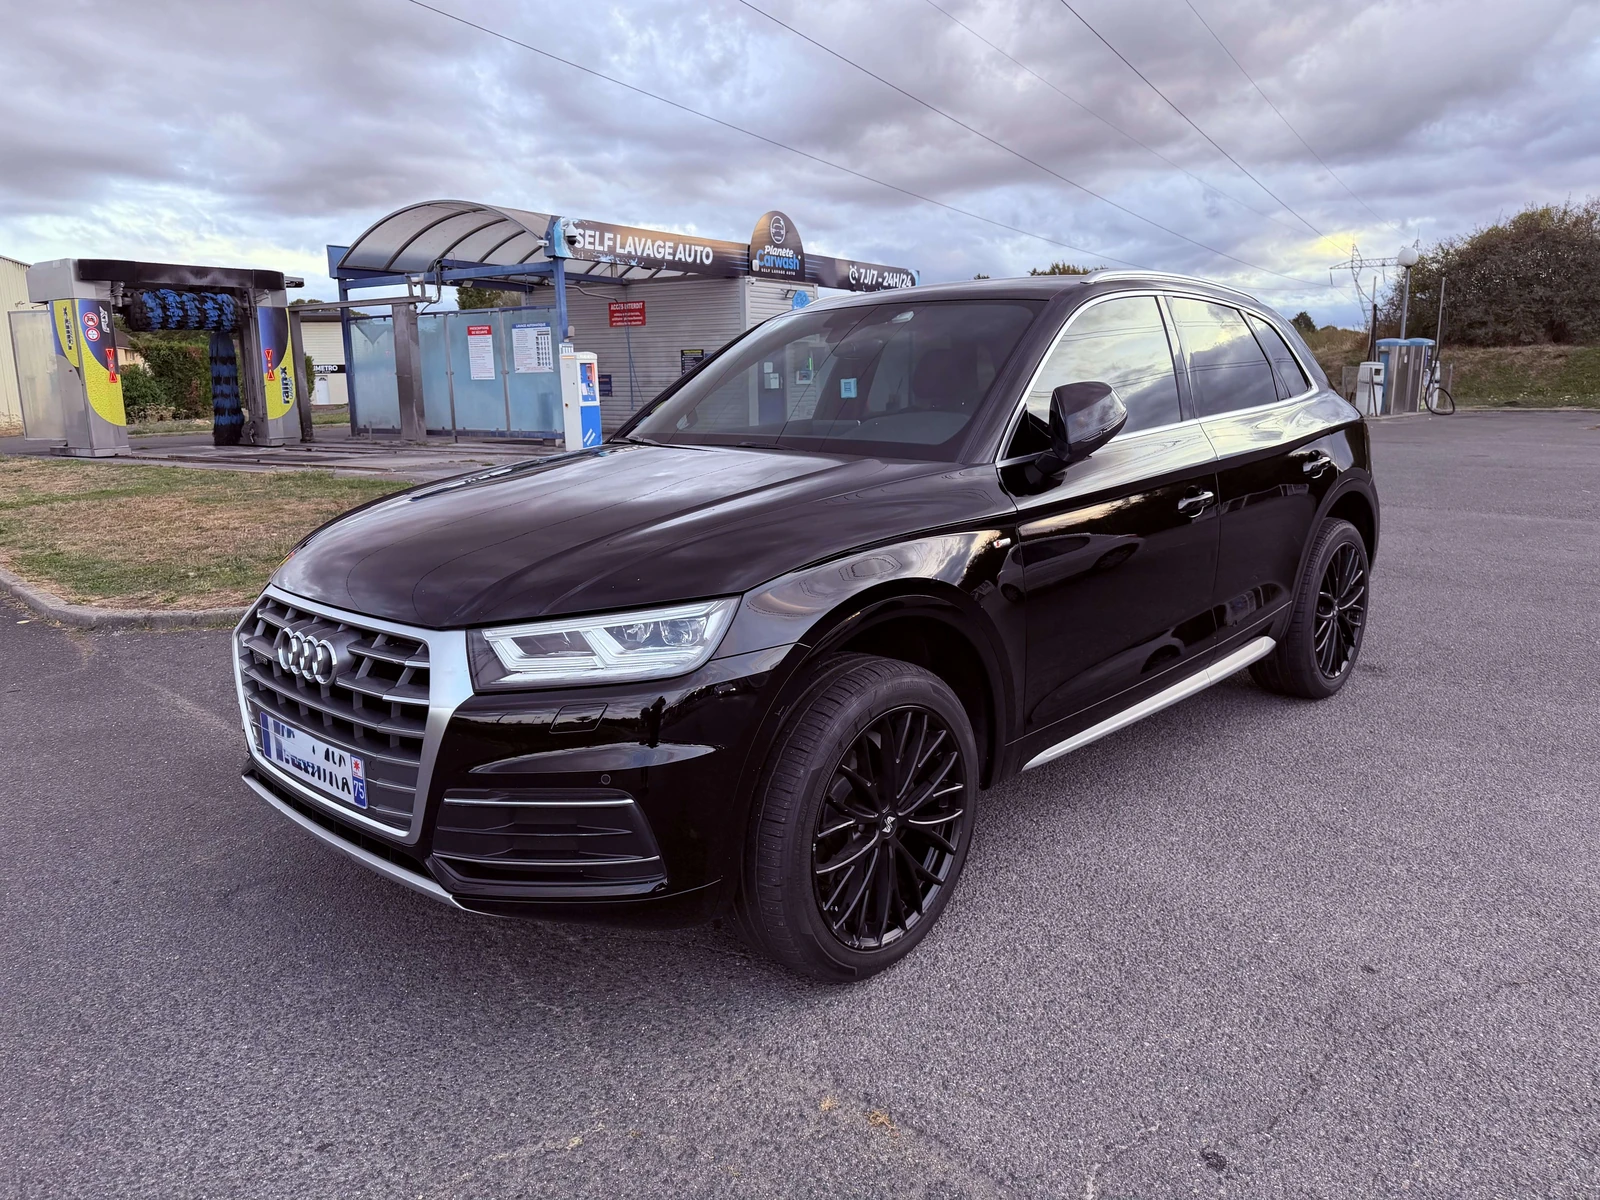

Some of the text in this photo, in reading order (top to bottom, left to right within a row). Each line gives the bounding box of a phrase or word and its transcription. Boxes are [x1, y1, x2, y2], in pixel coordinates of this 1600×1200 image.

[575, 228, 714, 265] SELF LAVAGE AUTO
[756, 249, 800, 270] Carwash
[860, 268, 878, 285] 7J/7
[883, 271, 912, 288] 24H/24
[353, 780, 365, 799] 75
